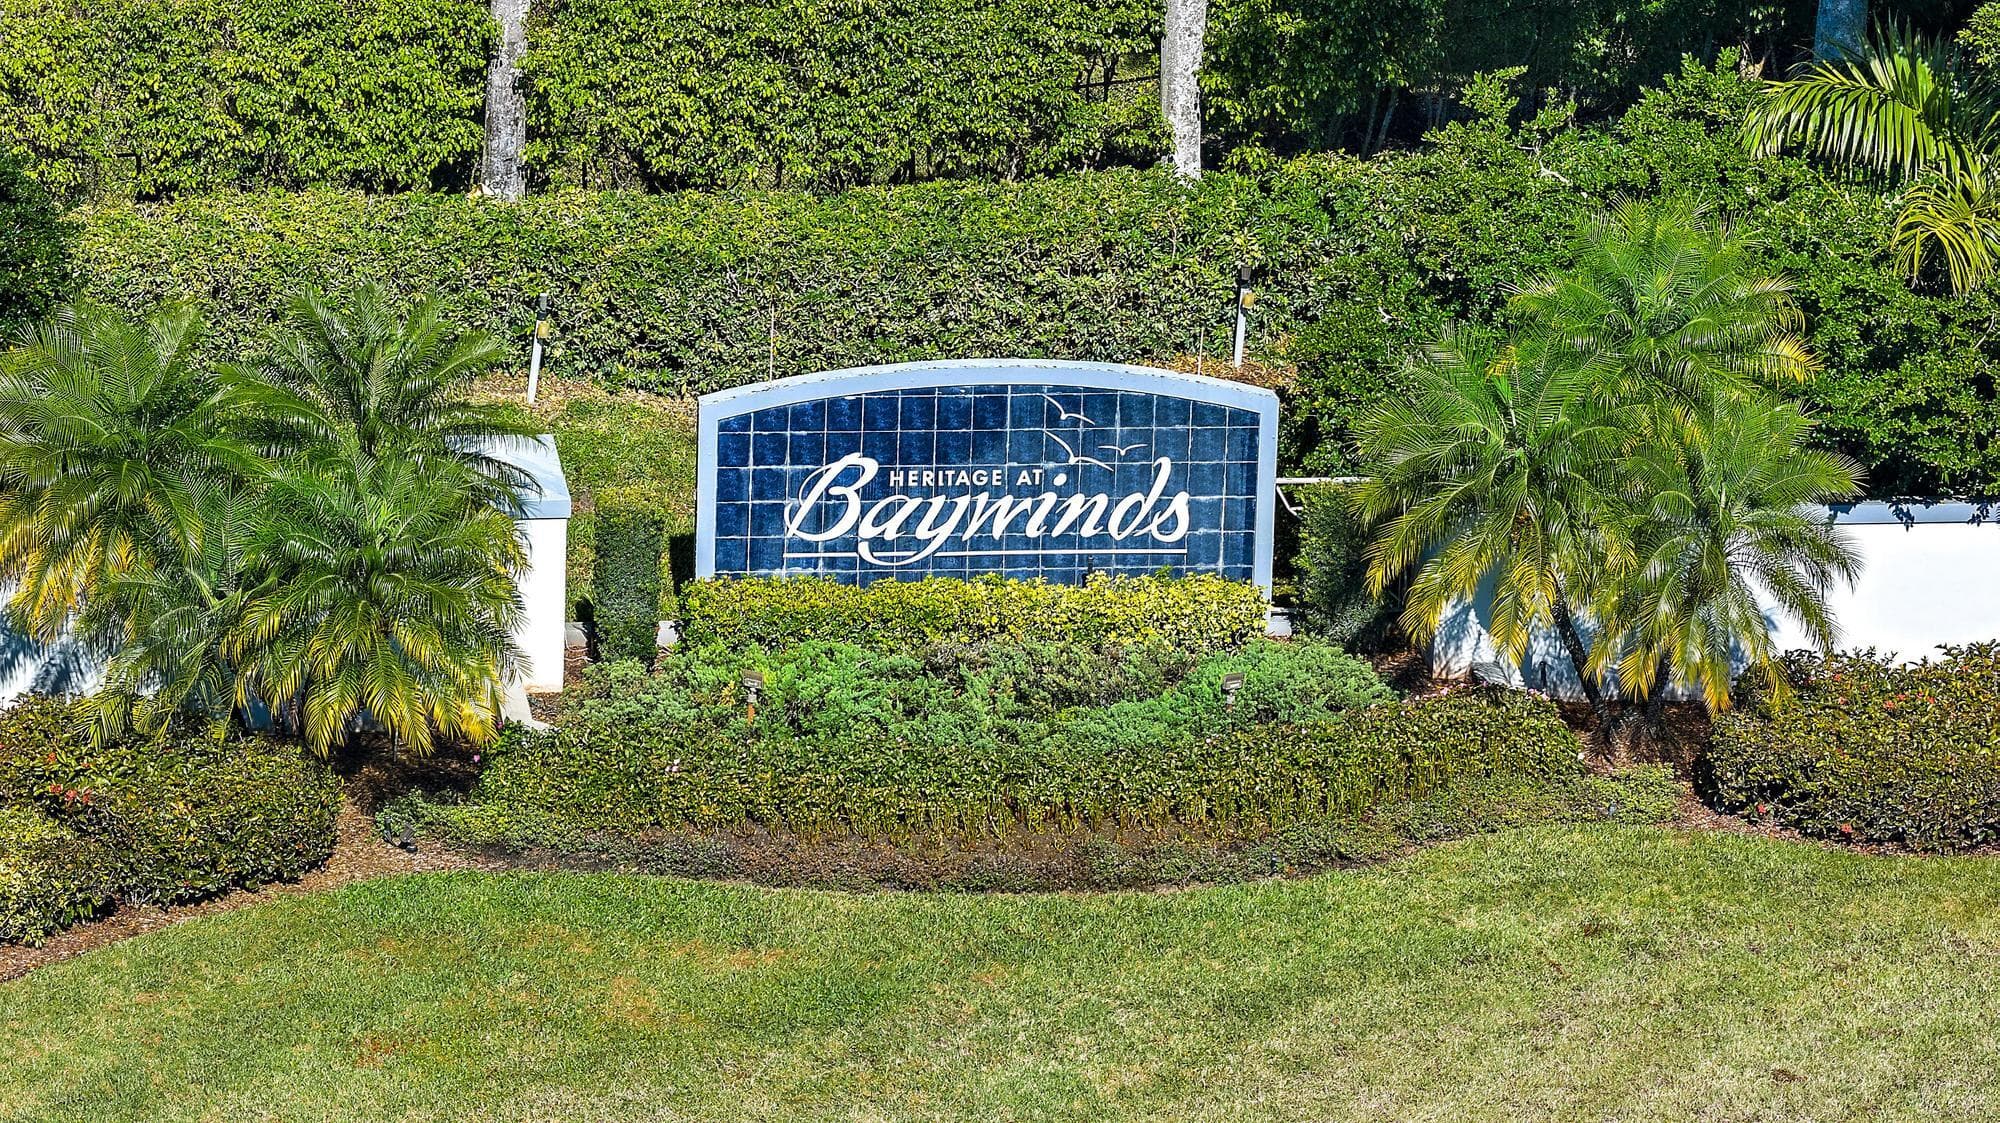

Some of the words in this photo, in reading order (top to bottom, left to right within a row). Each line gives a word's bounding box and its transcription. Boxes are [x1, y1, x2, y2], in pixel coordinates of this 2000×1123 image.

[784, 452, 1191, 566] Baywinds
[889, 469, 1002, 487] HERITAGE
[1016, 469, 1043, 486] AT
